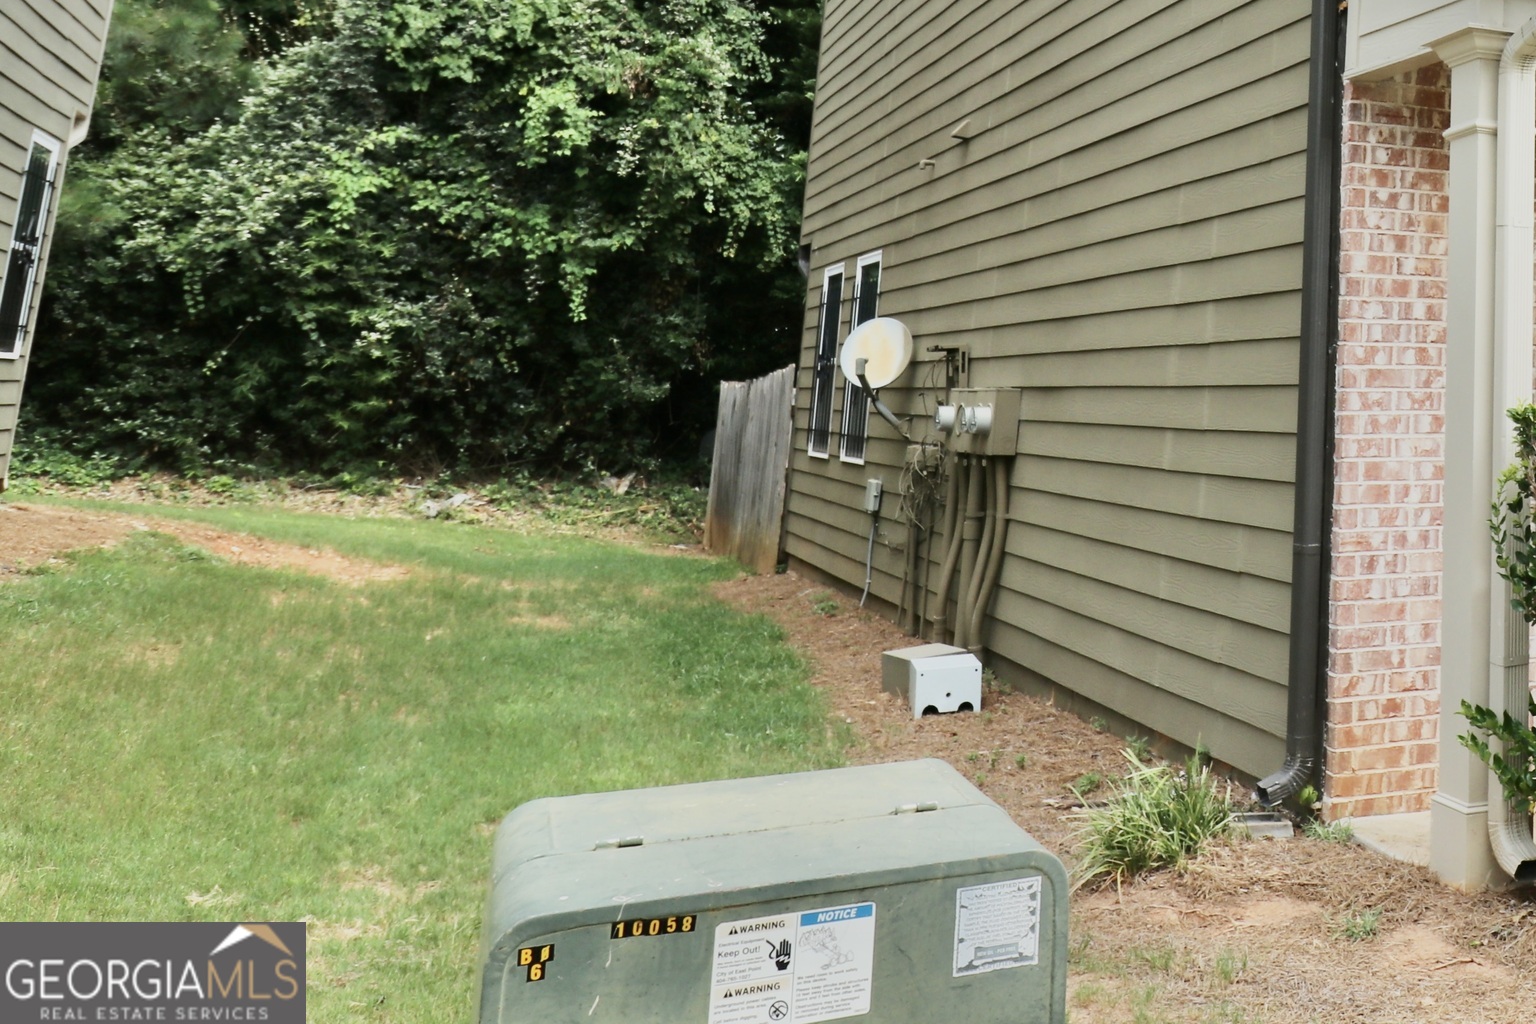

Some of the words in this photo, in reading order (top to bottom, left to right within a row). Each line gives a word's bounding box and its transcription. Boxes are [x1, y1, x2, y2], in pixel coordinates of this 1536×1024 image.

[817, 908, 858, 923] NOTICE
[616, 916, 692, 938] 10058
[740, 920, 786, 933] WARNING
[718, 950, 740, 959] Keep
[742, 946, 761, 955] Out!
[530, 964, 542, 981] 6
[734, 982, 781, 996] WARNING
